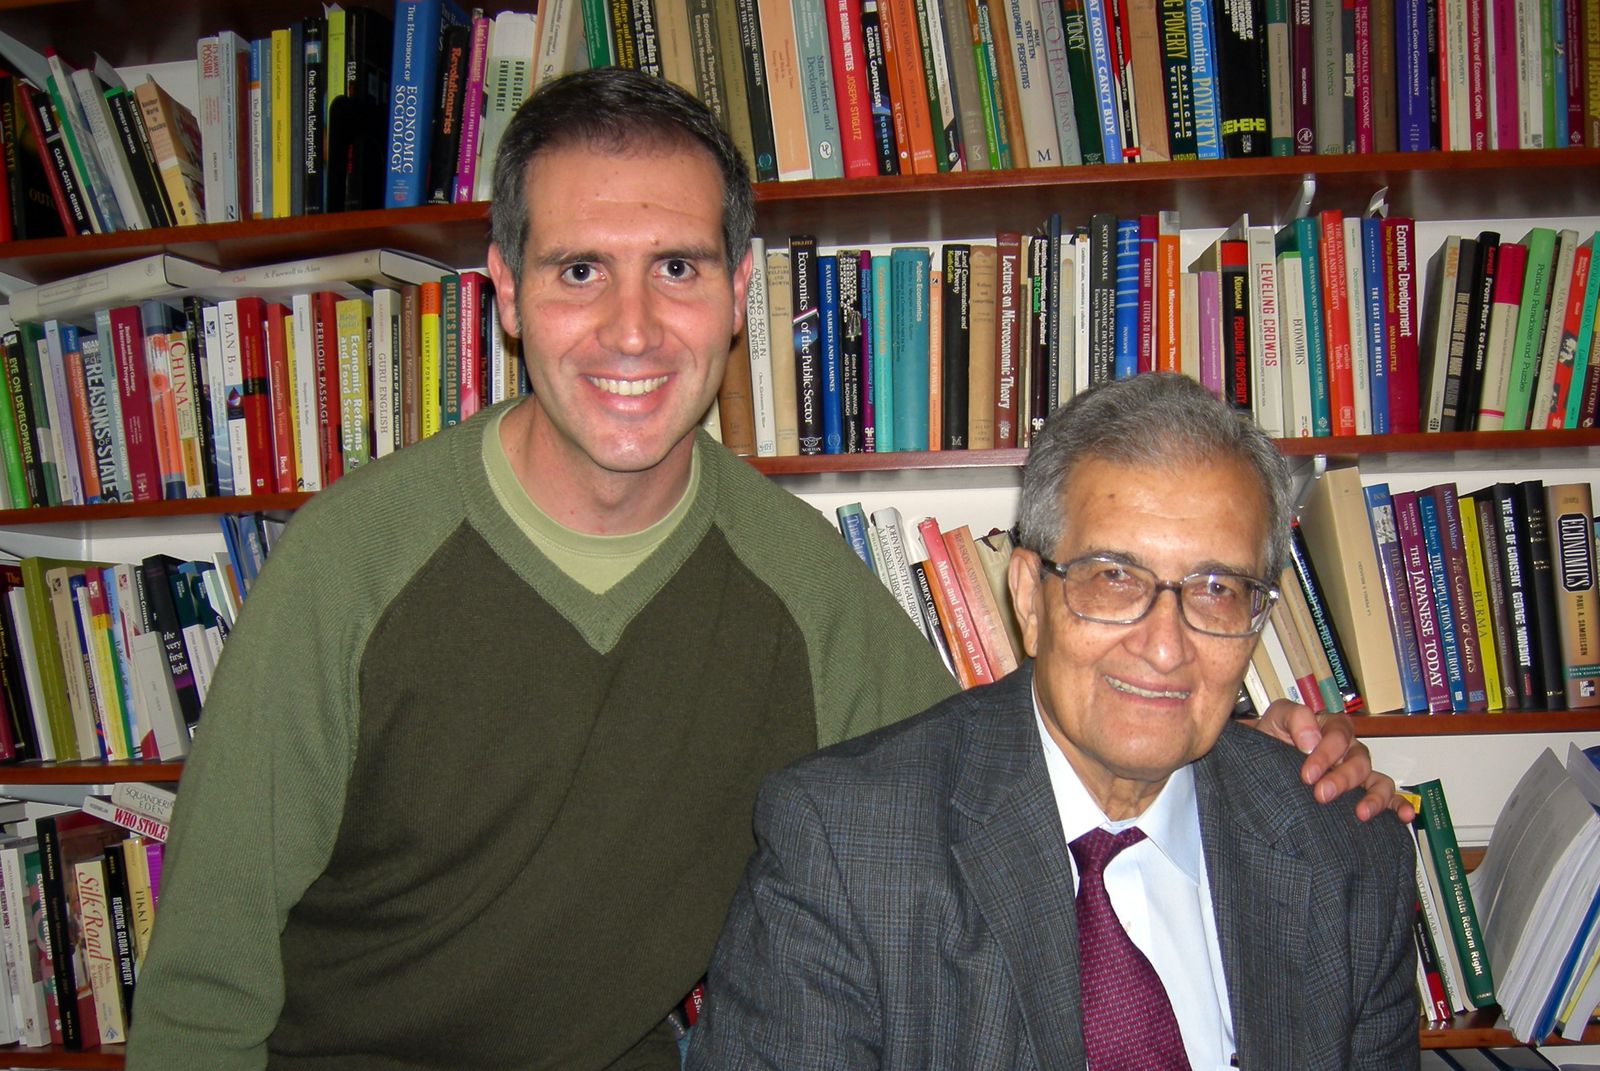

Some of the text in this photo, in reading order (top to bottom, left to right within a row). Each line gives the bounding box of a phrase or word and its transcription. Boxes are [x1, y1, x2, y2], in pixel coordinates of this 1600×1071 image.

[203, 45, 212, 80] POSSIBLE
[346, 62, 355, 80] FEAR
[403, 5, 416, 81] THE HANDBOOK OF
[702, 14, 720, 103] Economic Theory and
[866, 28, 882, 108] GLOBAL CAPITALISM
[1066, 15, 1086, 51] MONEY
[1163, 12, 1187, 59] POVERTY
[443, 49, 460, 134] Revolutionaries
[496, 61, 509, 112] ENVIRONMENT
[806, 57, 819, 115] Development
[846, 75, 861, 141] JOSEPH STIGLITZ
[1091, 17, 1115, 135] MONEY CAN'T BUY
[1170, 67, 1181, 139] WEINBERG
[1180, 66, 1191, 138] DANZIGER
[1189, 0, 1216, 150] Confronting POVERTY
[1343, 54, 1354, 98] social policy
[391, 85, 404, 173] SOCIOLOGY
[402, 87, 417, 173] ECONOMIC
[880, 117, 889, 156] NORBERG
[53, 149, 83, 222] CLASS, CASTE, GENDER
[825, 264, 834, 304] RAVALLION
[916, 261, 924, 322] Public Economics
[953, 250, 962, 294] Rural Poverty
[961, 250, 970, 329] Land Concentration and
[1326, 223, 1339, 312] WEALTH AND POVERTY
[1336, 223, 1347, 299] THE ECONOMICS OF
[1396, 225, 1411, 337] Economic Development
[445, 283, 456, 414] HITLER'S BENEFICIARIES
[753, 268, 767, 358] ADVANCING HEALTH IN
[795, 252, 814, 425] Economics of the Public Sector
[998, 255, 1016, 410] Lectures on Microeconomic Theory
[1233, 276, 1247, 405] KRUGMAN PEDDLING PROSPERITY
[1261, 263, 1277, 367] LEVELING CROWDS
[1293, 319, 1304, 366] ECONOMICS
[1372, 302, 1380, 321] EAST
[1373, 322, 1381, 344] ASIAN
[1475, 278, 1492, 372] From Marx to Lenin
[1518, 264, 1545, 393] Political Paradoxes and Puzzles
[168, 342, 187, 407] CHINA
[315, 322, 329, 425] PERILOUS PASSAGE
[340, 337, 354, 452] and Food Security
[350, 335, 362, 452] Economic Reforms
[378, 353, 388, 434] GURU ENGLISH
[828, 361, 836, 392] FAMINES
[1334, 344, 1343, 370] Tullock
[1343, 343, 1352, 370] Gordon
[1375, 346, 1383, 378] MIRACLE
[8, 358, 33, 465] EYE ON DEVELOPMENT
[280, 455, 289, 475] Beck
[1443, 491, 1458, 551] Michael Walzer
[1560, 519, 1589, 588] ECONOMICS
[916, 568, 940, 627] COMMON CRISIS
[937, 561, 984, 679] Marx and Engels on Law
[1409, 546, 1442, 688] THE JAPANESE TODAY
[1424, 505, 1460, 683] Livi Bacci THE POPULATION OF EUROPE
[1472, 591, 1487, 639] BURMA
[1501, 498, 1530, 667] THE AGE OF CONSENT GEORGE MONBIOT
[113, 808, 168, 840] WHO STOLE
[139, 801, 165, 816] EDEN
[78, 872, 112, 963] Silk Road
[112, 897, 132, 986] REDUCING GLOBAL POVERTY
[1444, 848, 1484, 977] Getting Health Reform Right
